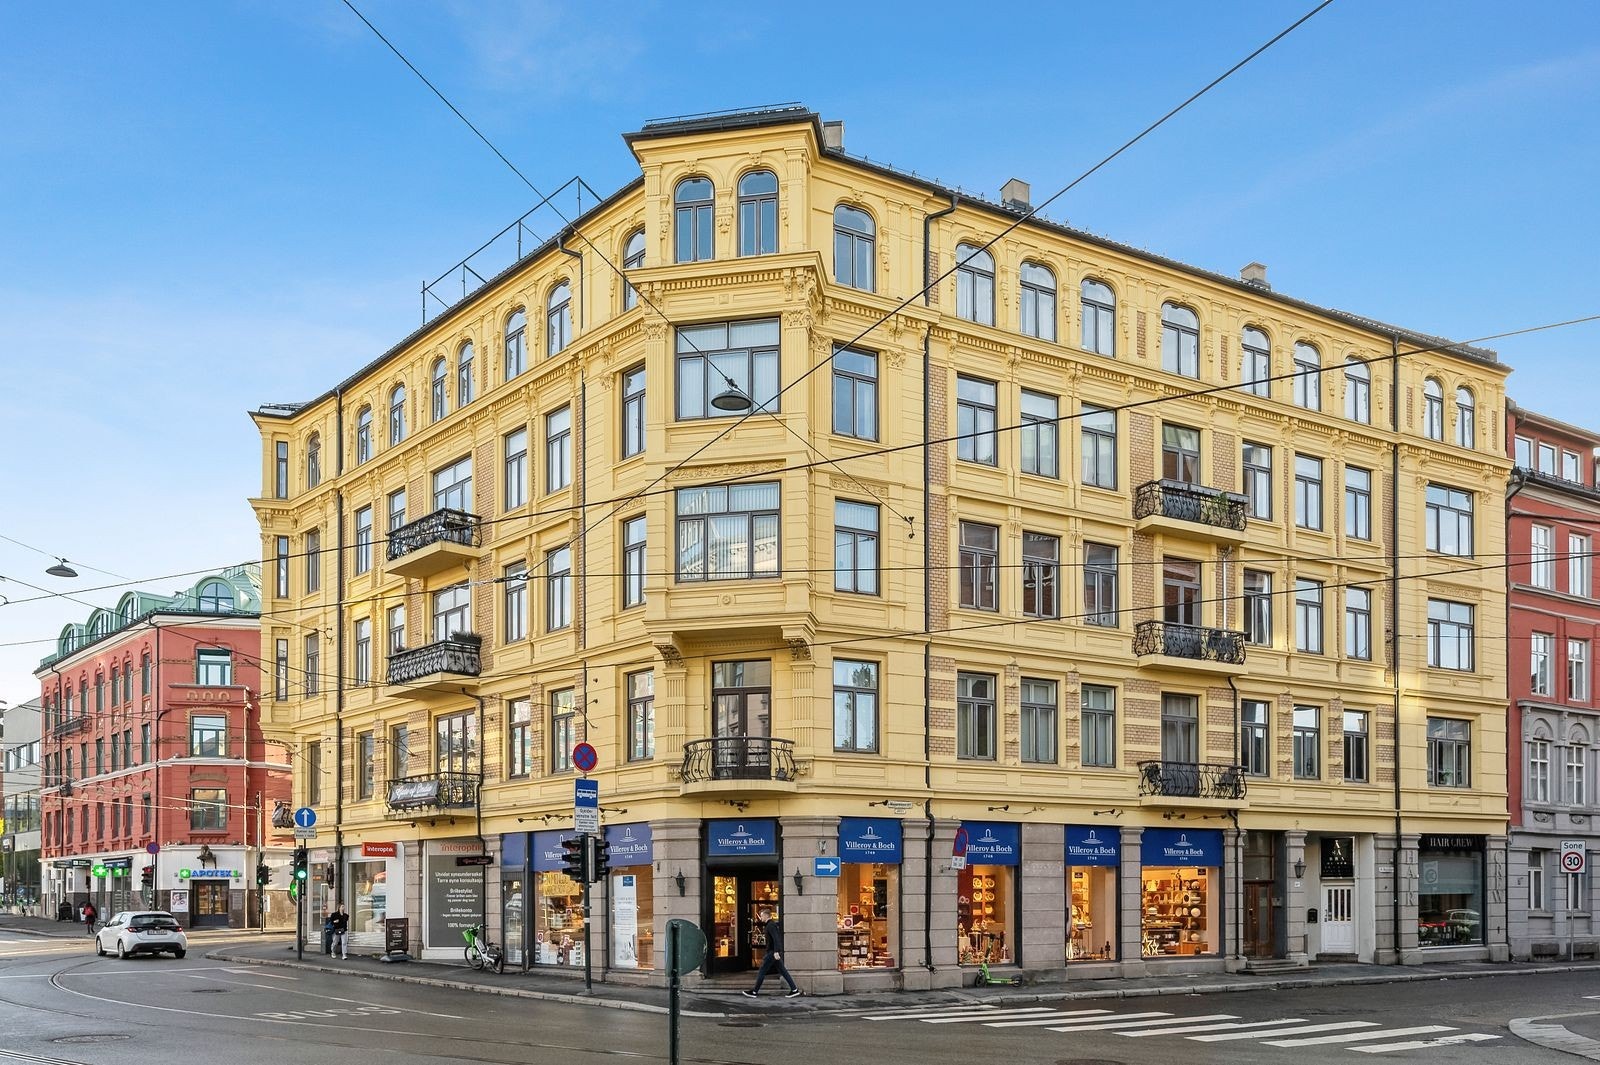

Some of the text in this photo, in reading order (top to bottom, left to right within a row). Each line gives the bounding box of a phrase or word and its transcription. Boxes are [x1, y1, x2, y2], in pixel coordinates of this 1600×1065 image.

[846, 841, 872, 849] Villeroy
[1430, 838, 1472, 847] HAIR CREW
[610, 845, 630, 853] Villeroy
[1069, 846, 1093, 854] Villeroy
[1567, 856, 1580, 866] 30
[1405, 850, 1415, 906] HAIR
[252, 1007, 401, 1019] BUSS
